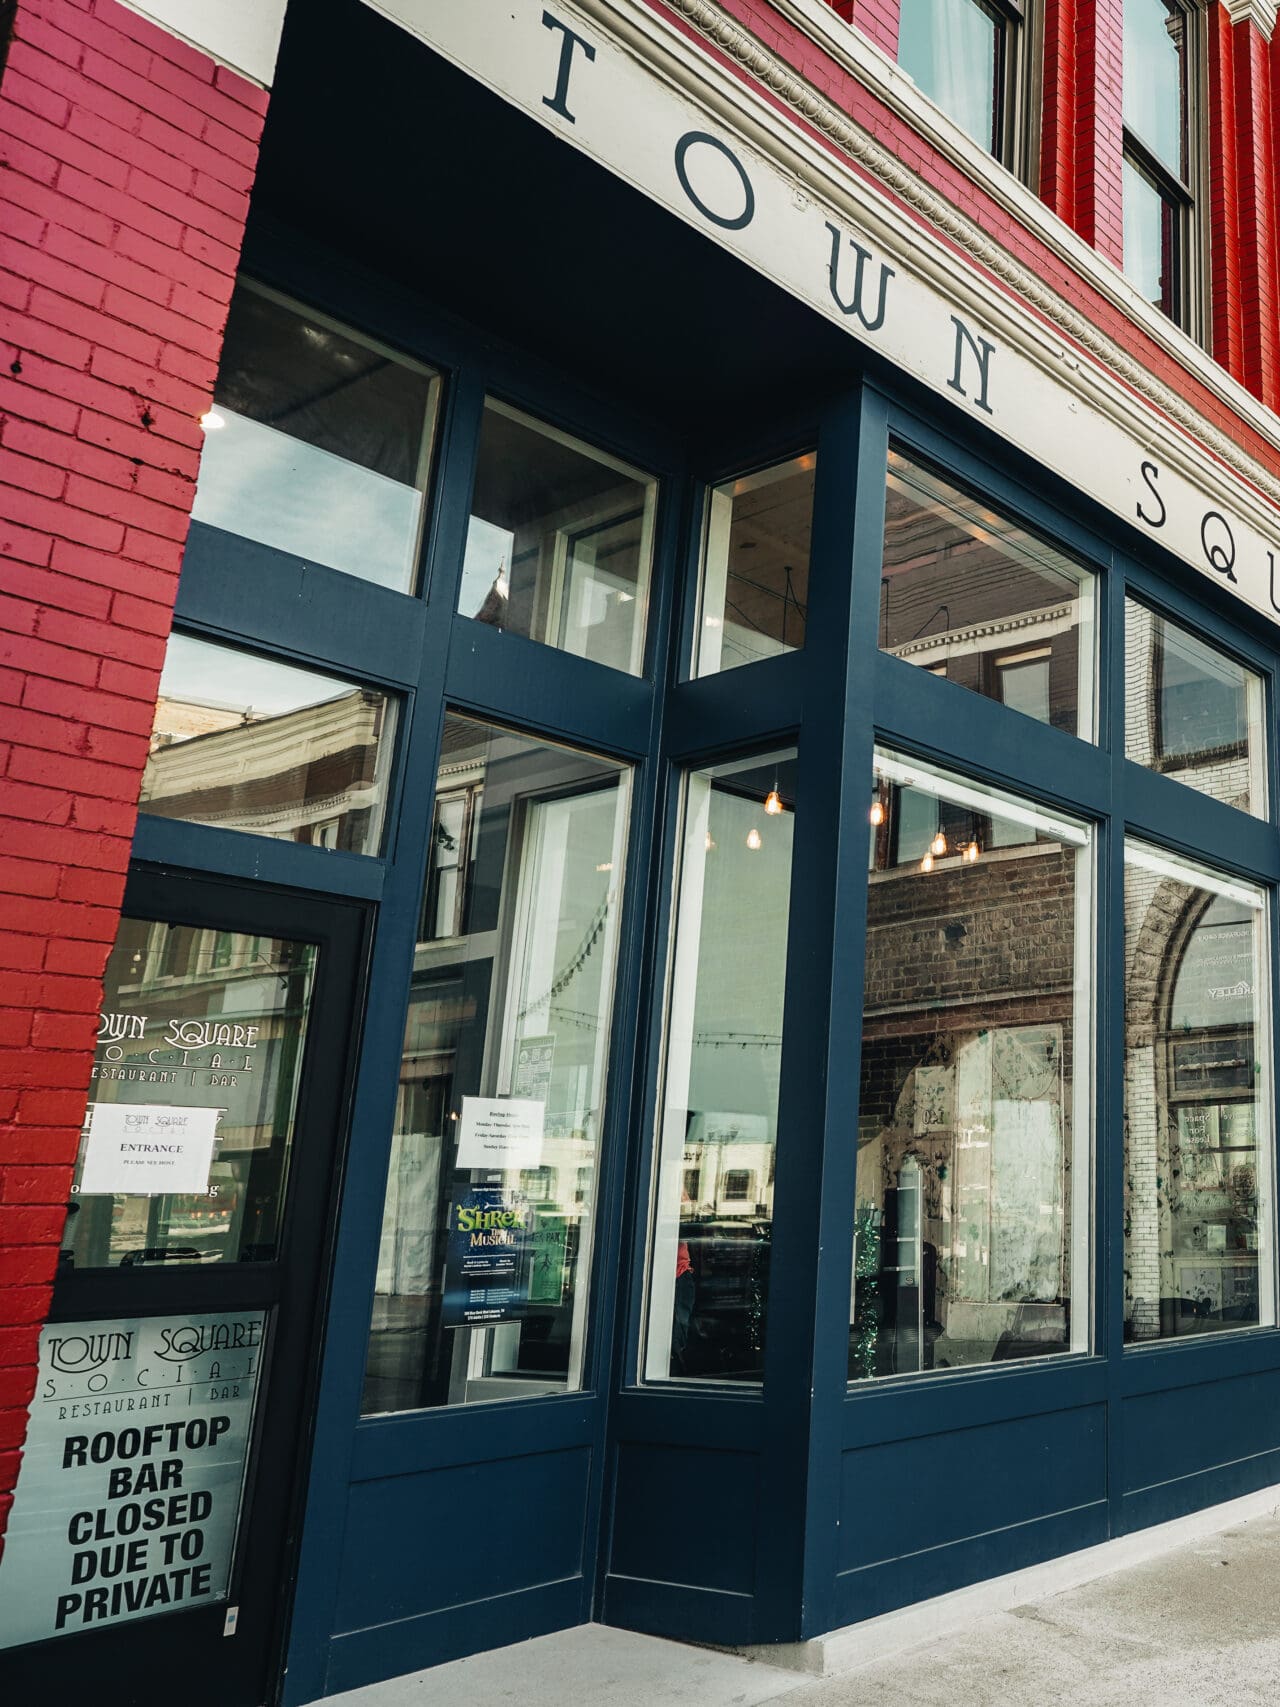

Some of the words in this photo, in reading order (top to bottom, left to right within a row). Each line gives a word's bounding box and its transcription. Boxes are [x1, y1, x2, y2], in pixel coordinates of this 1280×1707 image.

[542, 10, 995, 415] TOWN
[164, 1019, 259, 1050] SQUARE
[91, 1067, 178, 1083] ESTAURANT
[210, 1074, 238, 1087] BAR
[120, 1143, 183, 1153] ENTRANCE
[48, 1331, 135, 1373] TOWN
[154, 1320, 262, 1362] SQUARE
[58, 1393, 171, 1420] RESTAURANT
[209, 1385, 241, 1401] BAR
[62, 1415, 231, 1469] ROOFTOP
[108, 1458, 184, 1499] BAR
[68, 1490, 213, 1546] CLOSED
[71, 1539, 148, 1586] DUE
[160, 1529, 204, 1566] TO
[55, 1563, 212, 1630] PRIVATE
